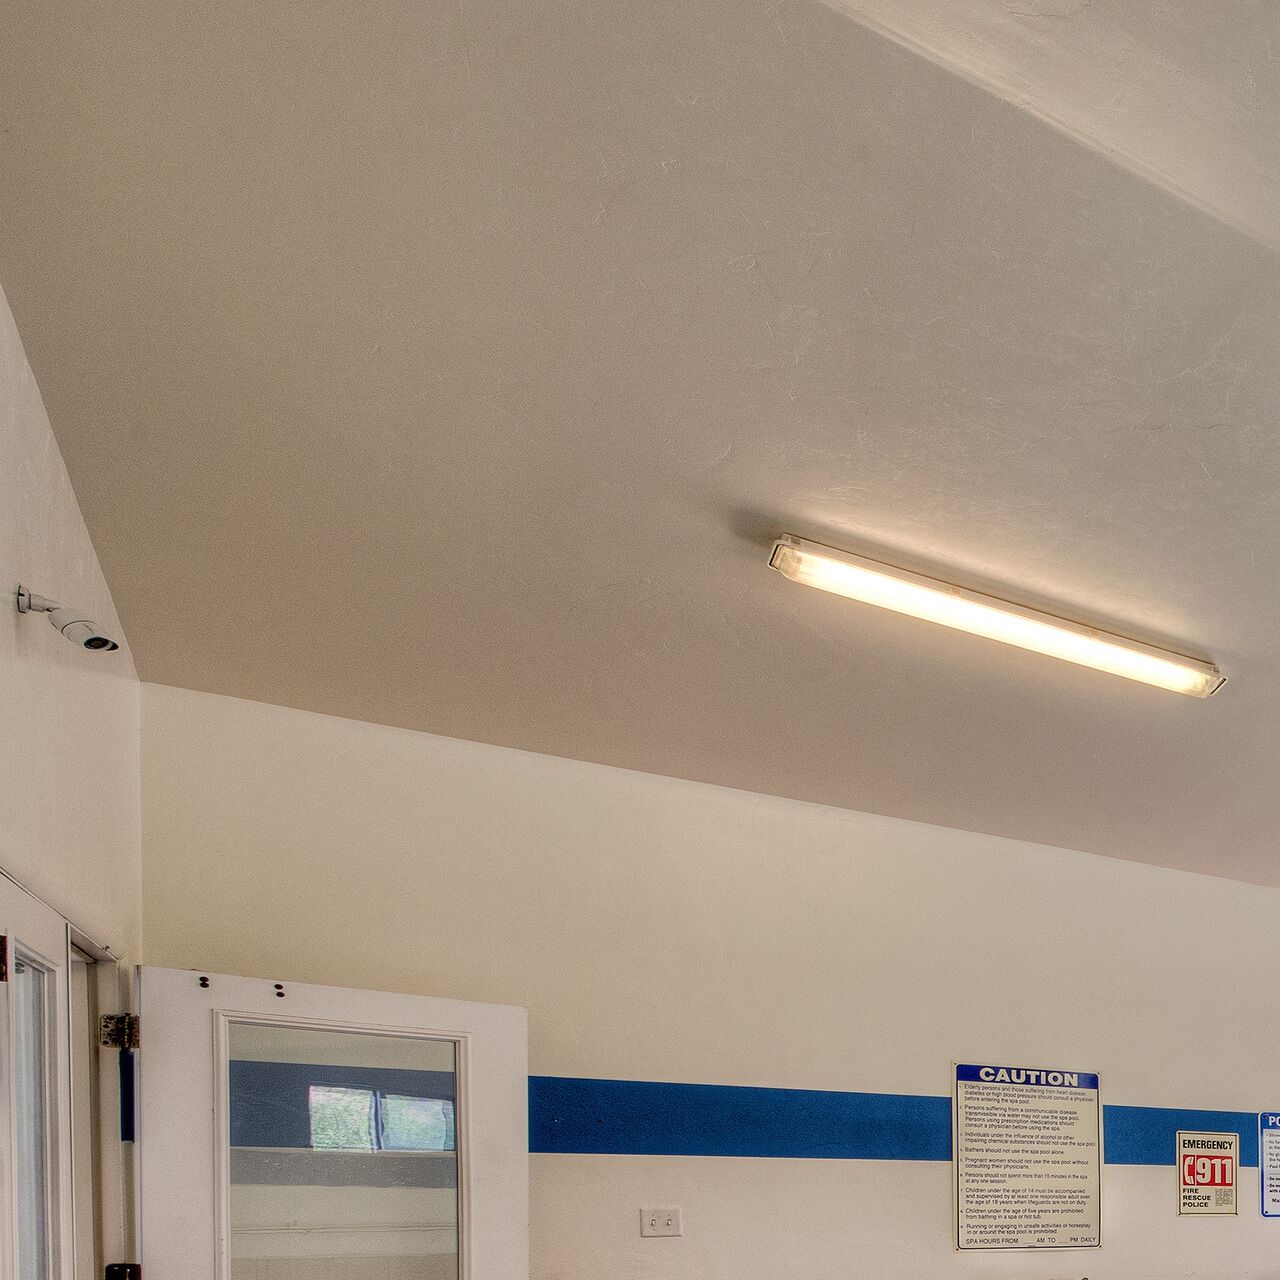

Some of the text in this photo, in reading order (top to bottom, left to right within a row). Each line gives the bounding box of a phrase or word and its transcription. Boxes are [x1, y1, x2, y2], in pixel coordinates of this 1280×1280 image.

[979, 1068, 1078, 1086] CAUTION
[1183, 1140, 1233, 1150] EMERGENCY
[1197, 1158, 1232, 1184] 911
